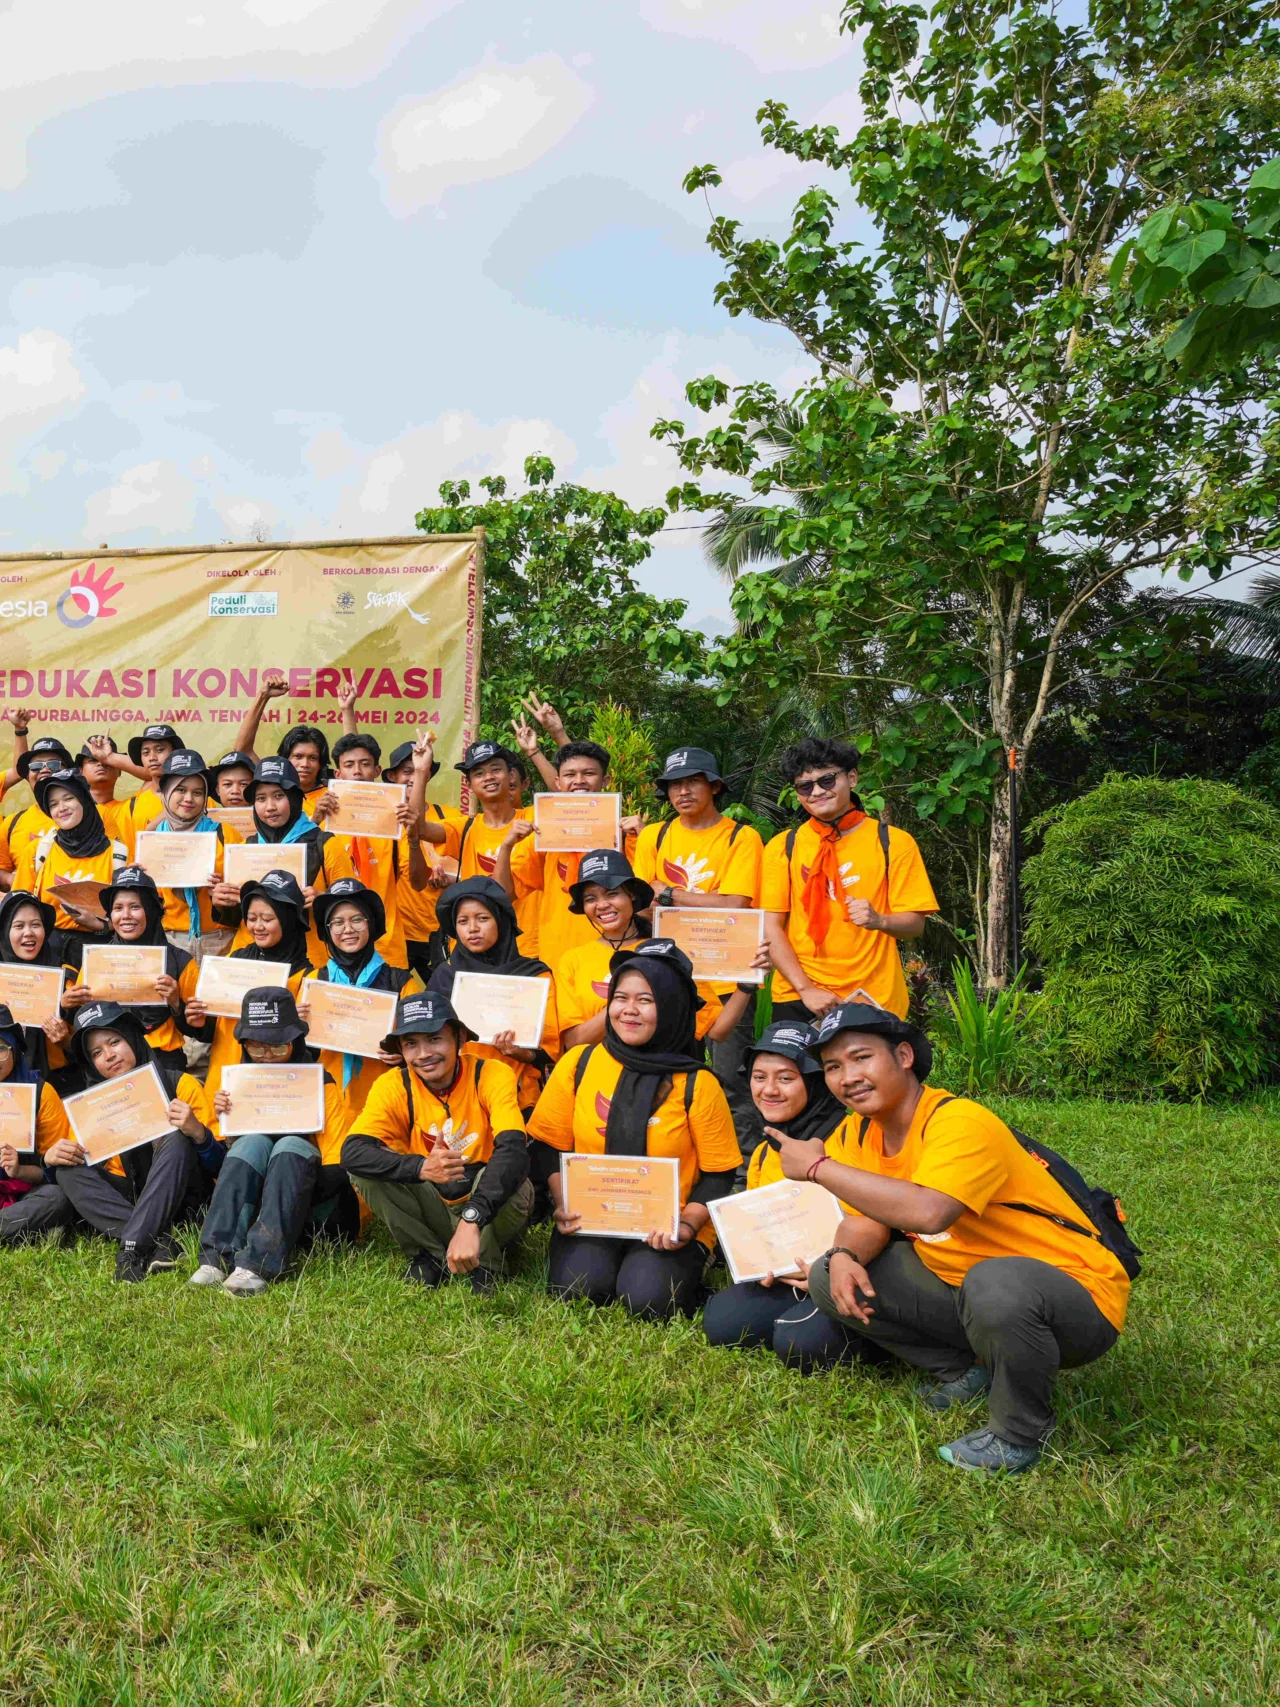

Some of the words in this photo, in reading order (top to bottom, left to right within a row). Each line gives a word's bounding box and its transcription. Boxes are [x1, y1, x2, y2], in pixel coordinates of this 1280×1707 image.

[207, 569, 249, 577] DIKELOLA
[322, 567, 400, 575] BERKOLABORASI
[0, 575, 23, 583] OLEH
[211, 595, 247, 605] Peduli
[210, 603, 275, 614] Konservasi
[28, 709, 149, 724] PURBALINGGA,
[155, 709, 202, 722] JAWA
[208, 709, 281, 723] TENH
[355, 710, 387, 724] MEI
[394, 710, 440, 724] 2024
[601, 1177, 640, 1185] SERTIFIKAT
